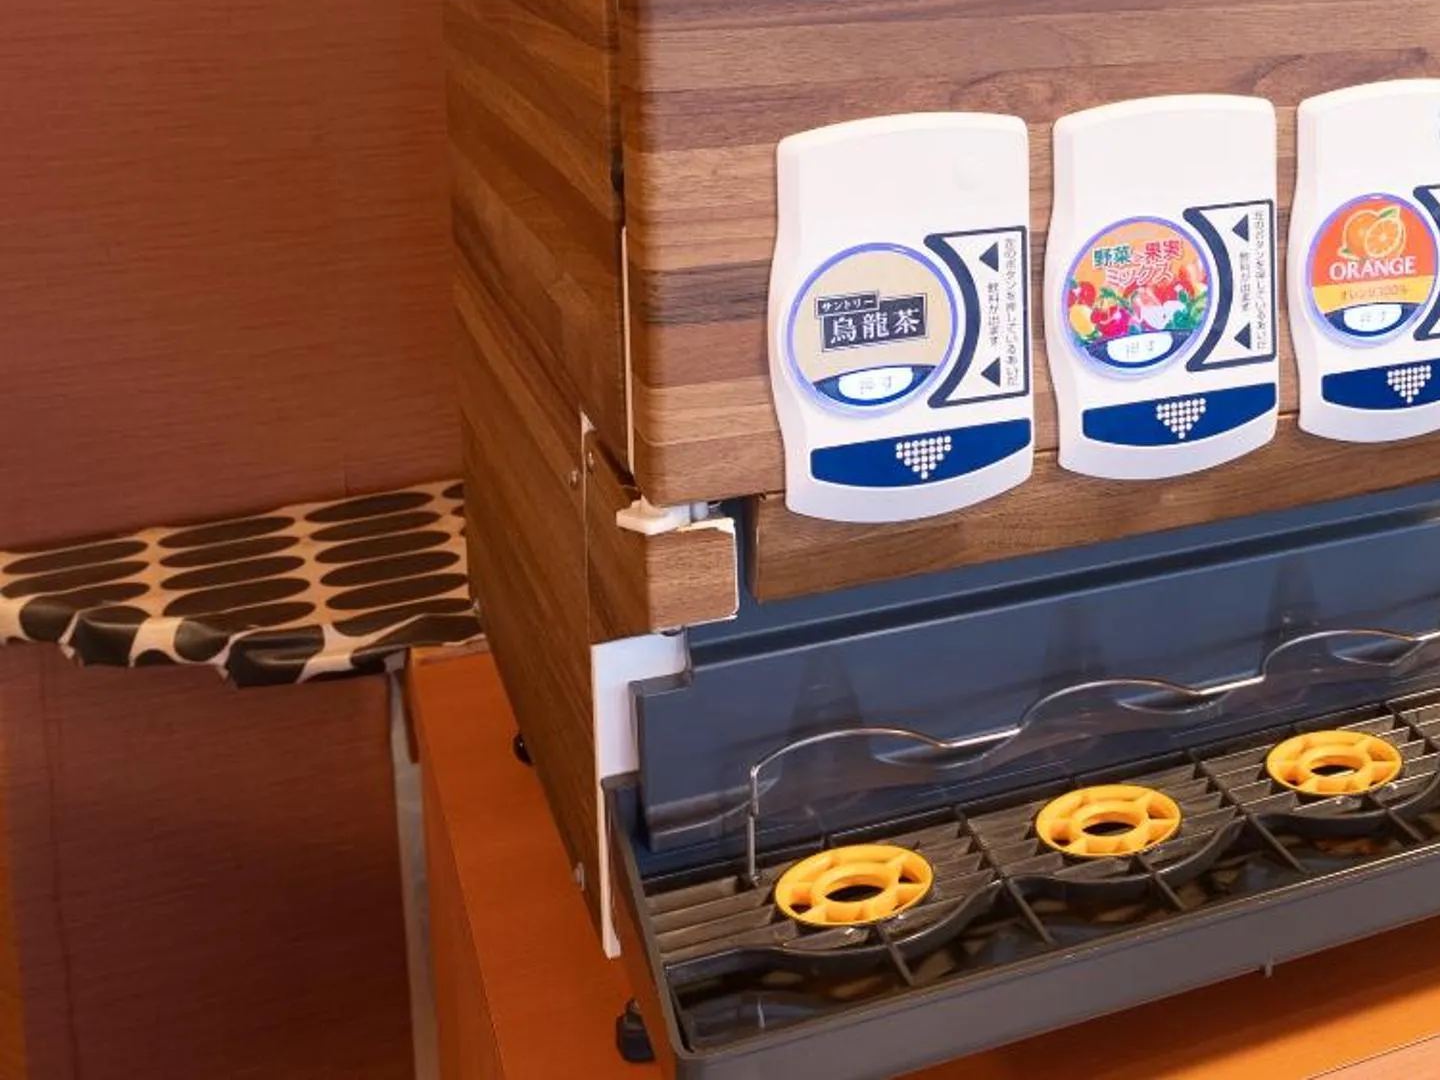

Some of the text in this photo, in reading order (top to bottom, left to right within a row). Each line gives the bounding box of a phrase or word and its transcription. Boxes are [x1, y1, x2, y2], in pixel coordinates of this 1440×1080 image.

[1106, 263, 1174, 287] ミックス
[1328, 255, 1417, 281] ORANGE
[821, 298, 874, 312] サントリー
